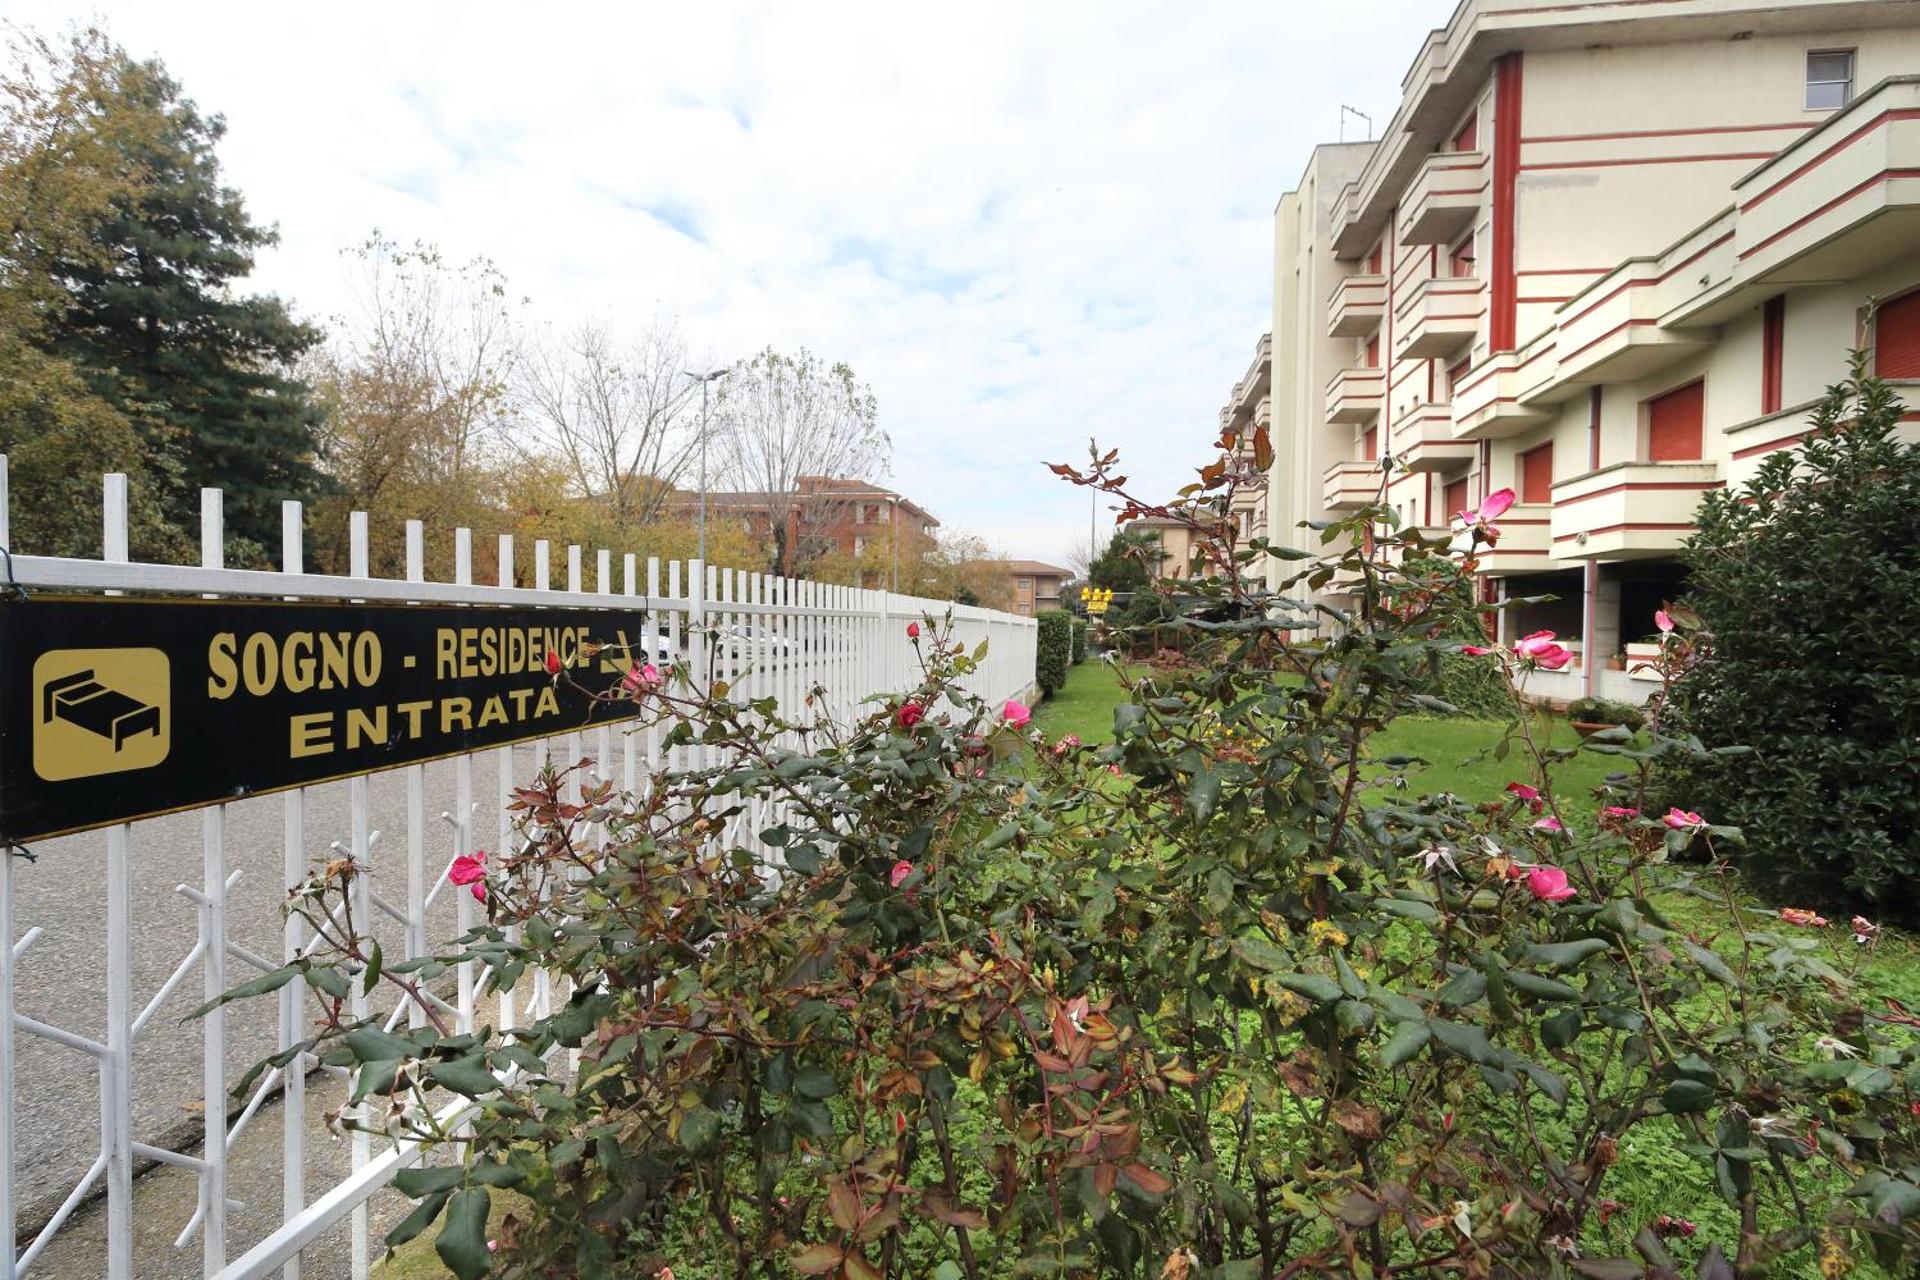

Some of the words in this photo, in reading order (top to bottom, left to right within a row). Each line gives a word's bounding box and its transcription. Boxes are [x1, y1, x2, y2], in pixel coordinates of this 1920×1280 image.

[208, 630, 382, 699] SOGNO
[437, 627, 590, 680] RESIDENCE
[290, 687, 560, 759] ENTRATA
